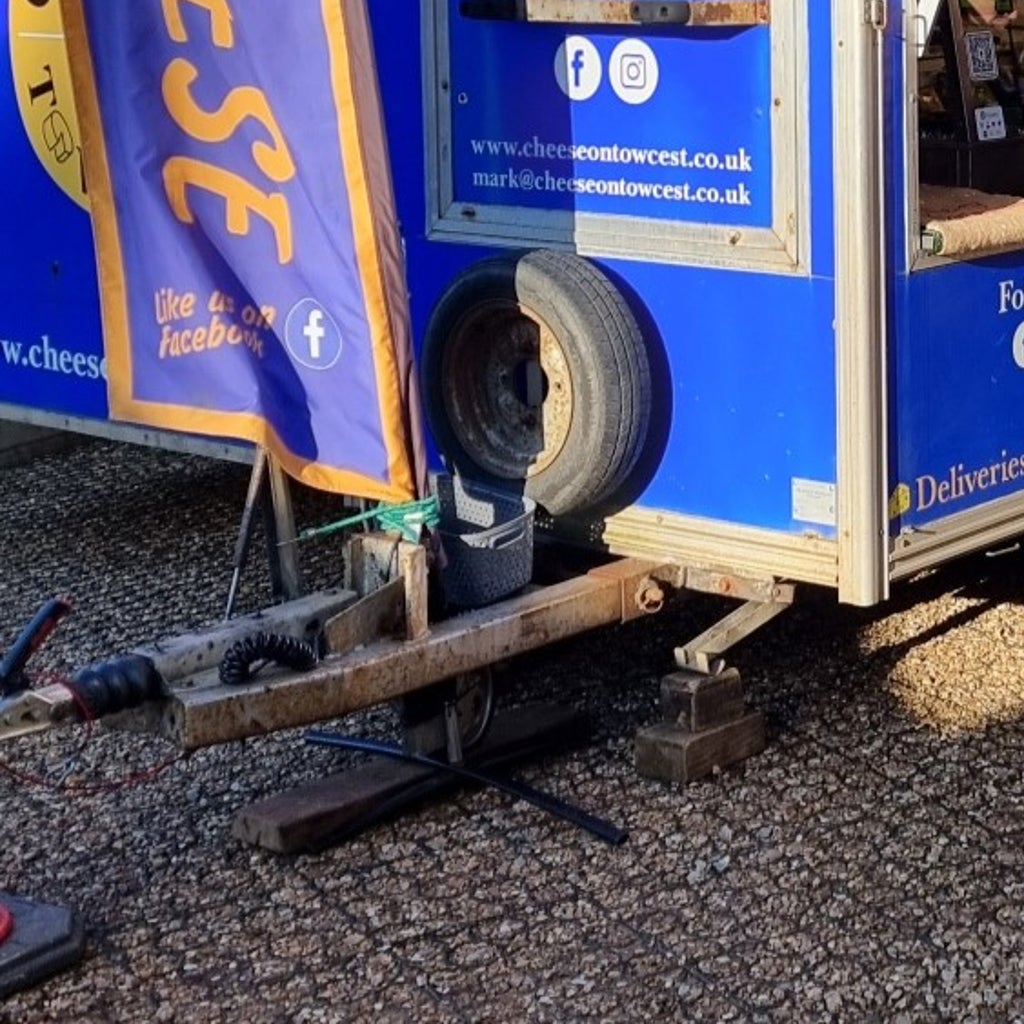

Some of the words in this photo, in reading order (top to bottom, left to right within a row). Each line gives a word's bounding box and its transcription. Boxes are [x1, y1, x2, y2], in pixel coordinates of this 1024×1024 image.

[470, 136, 753, 172] www.cheeseontowcest.co.uk
[472, 168, 752, 206] mark@cheeseontowcest.co.uk
[207, 289, 235, 313] us
[241, 304, 278, 330] on
